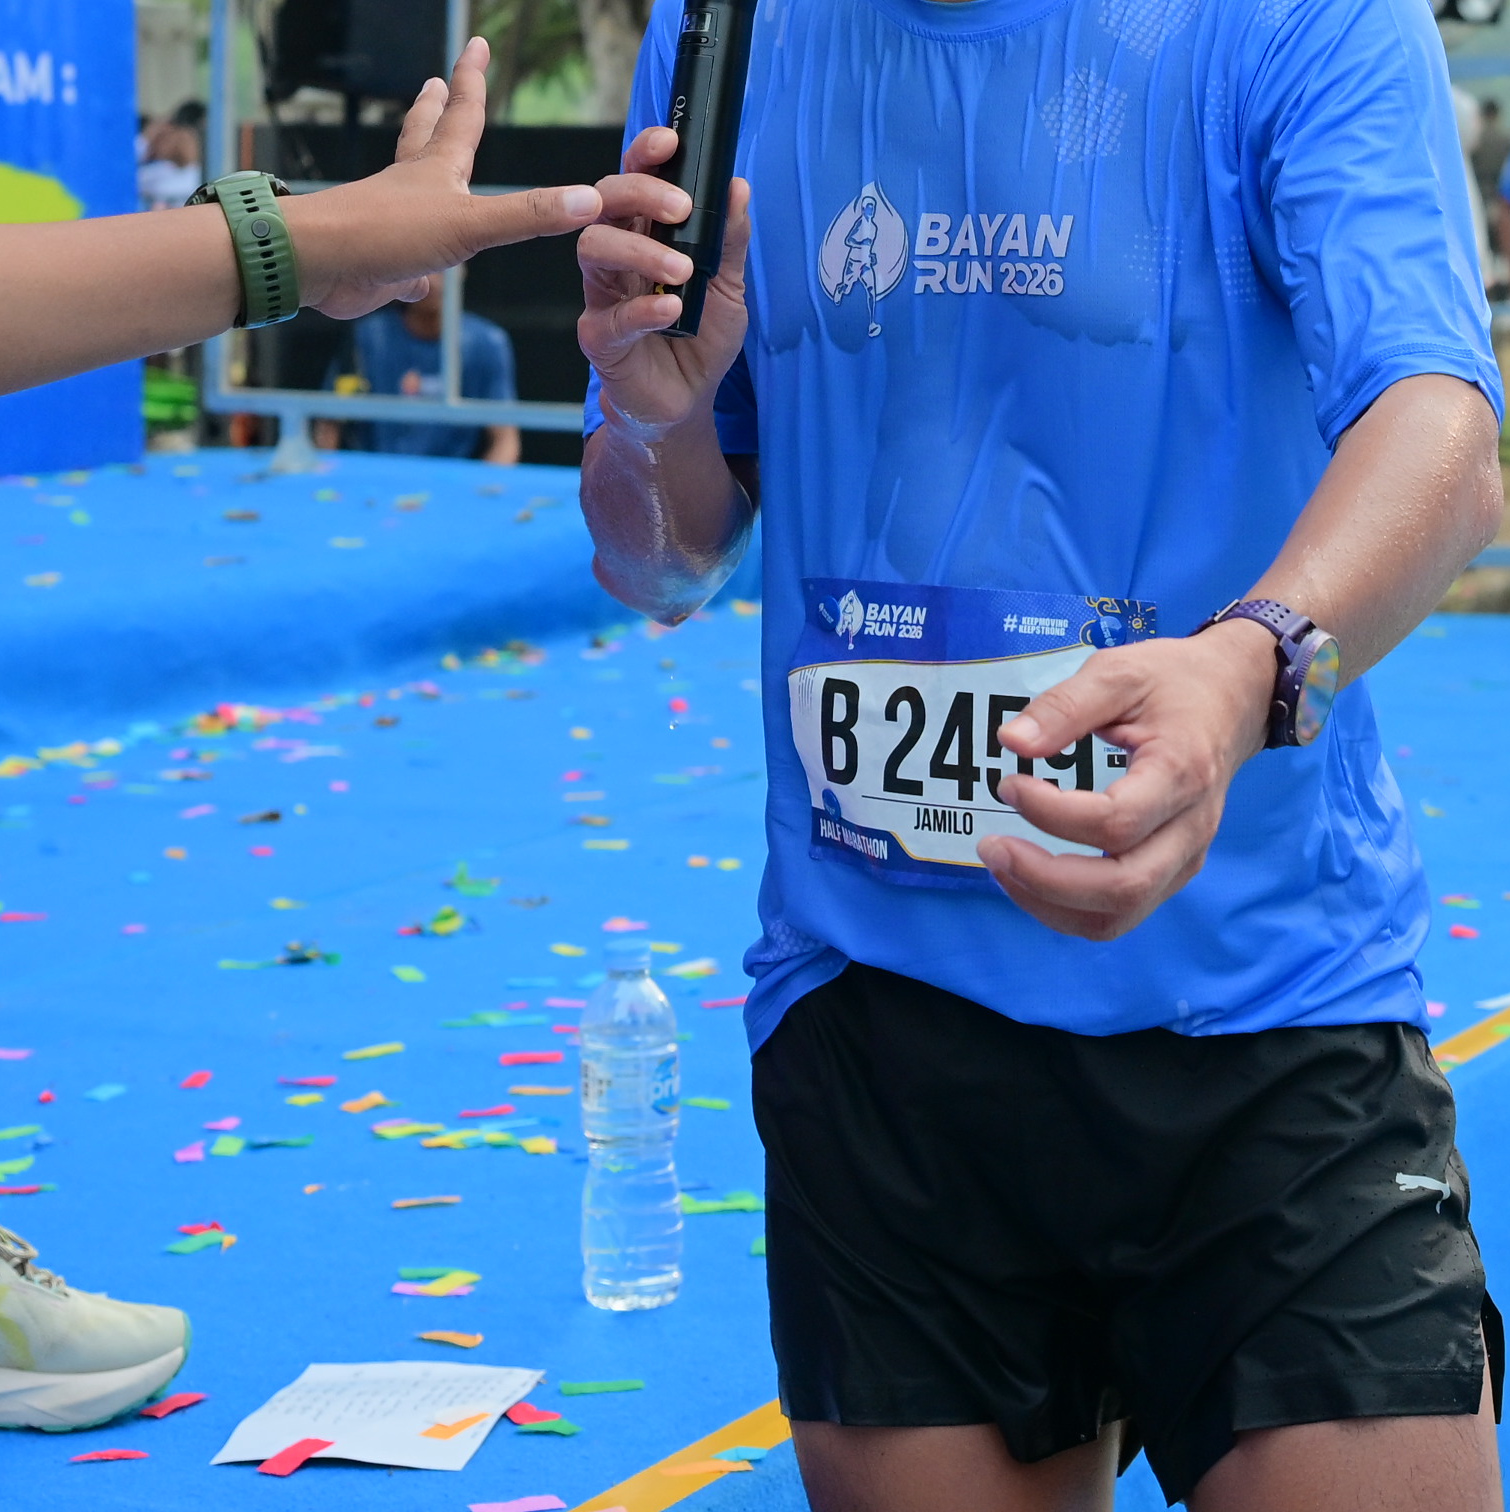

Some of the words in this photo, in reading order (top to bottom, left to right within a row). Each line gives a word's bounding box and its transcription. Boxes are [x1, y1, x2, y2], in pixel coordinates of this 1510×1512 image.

[915, 212, 1074, 258] BAYAN
[913, 260, 993, 294] RUN
[999, 262, 1064, 296] 2026
[864, 621, 896, 637] RUN
[898, 624, 923, 639] 2026
[865, 602, 927, 625] BAYAN
[821, 677, 860, 786] B
[819, 817, 842, 842] HALF
[841, 825, 888, 861] MARATHON
[914, 807, 973, 836] JAMILO
